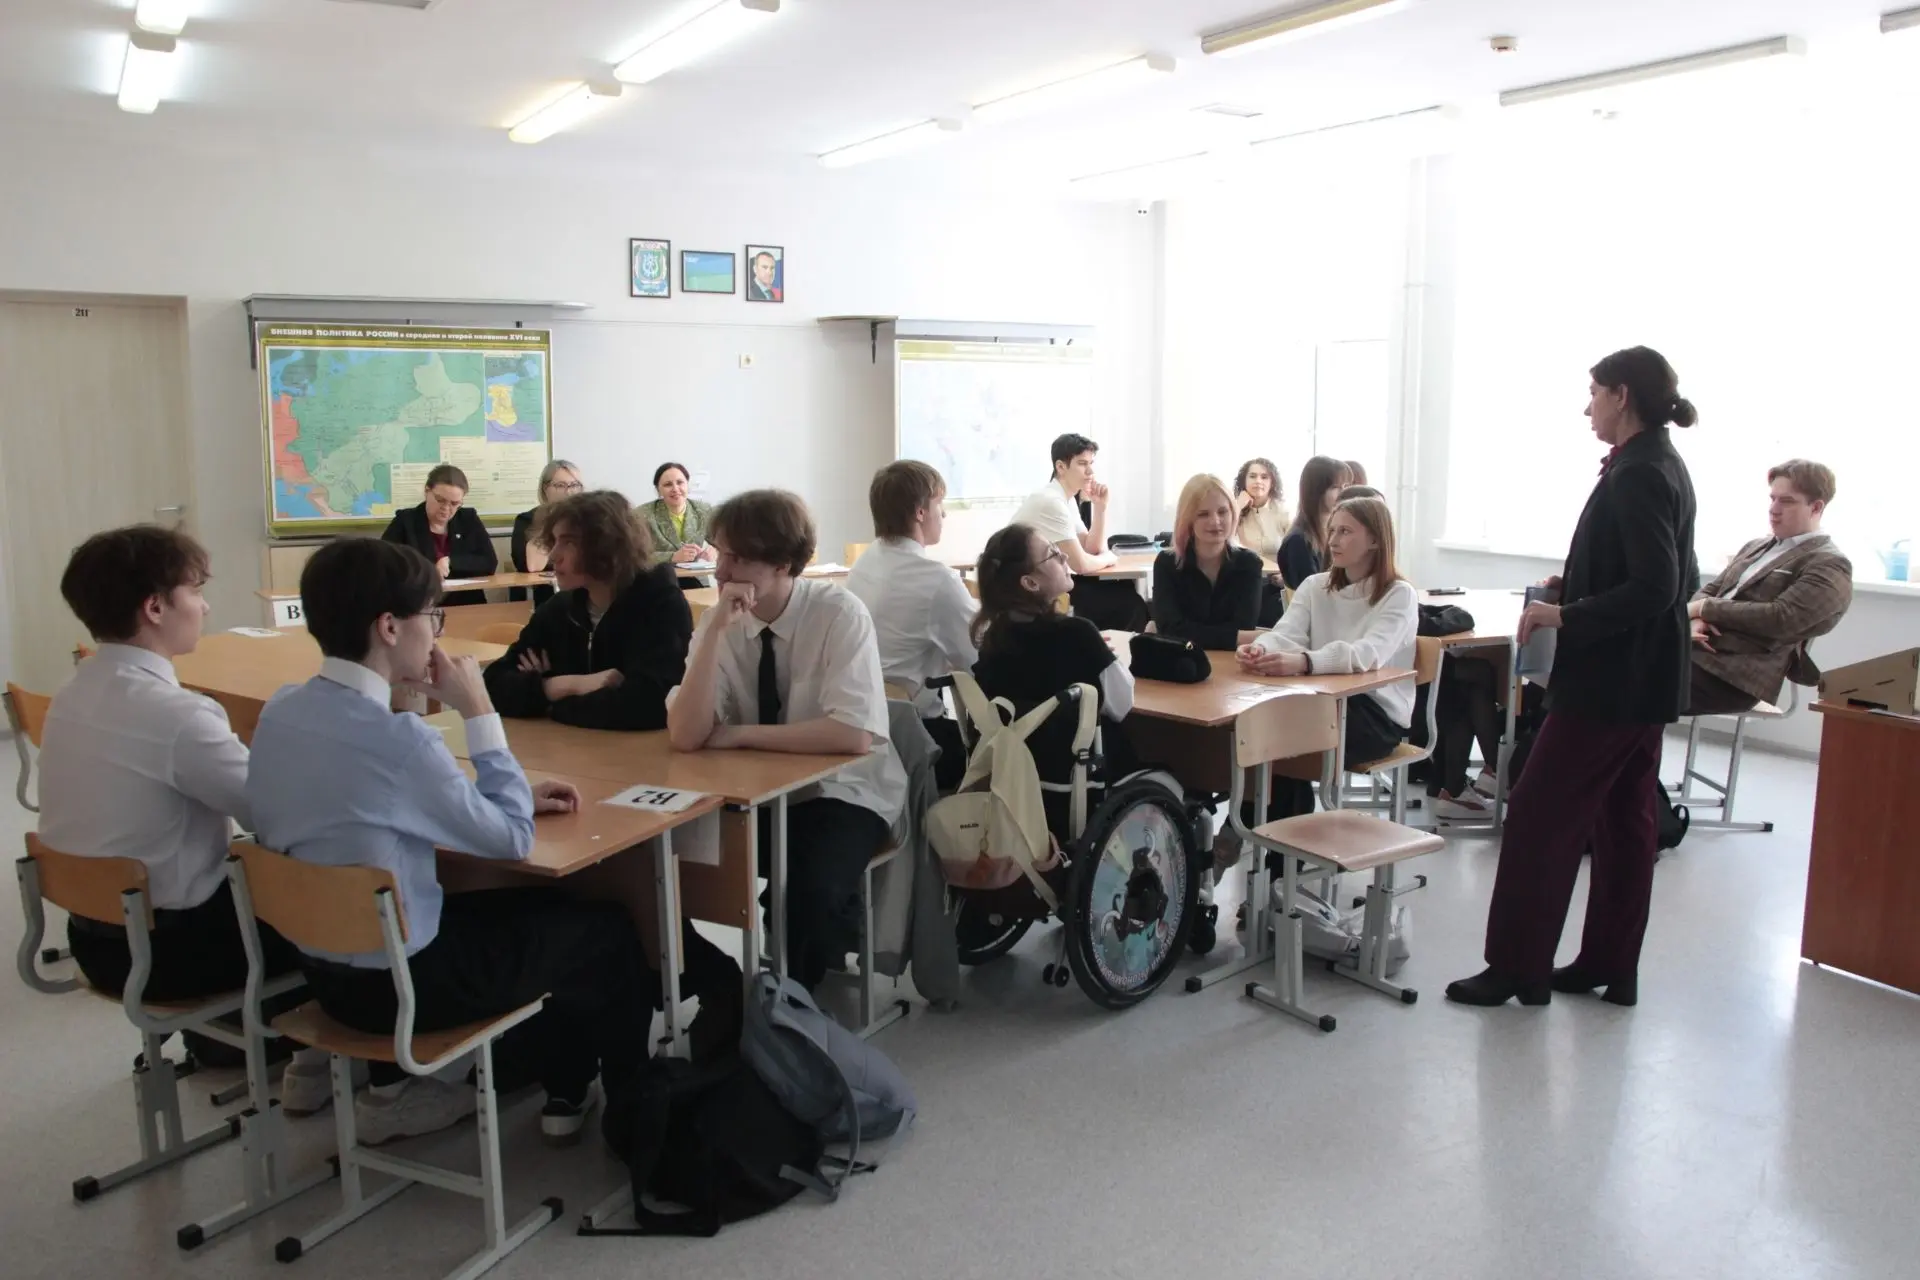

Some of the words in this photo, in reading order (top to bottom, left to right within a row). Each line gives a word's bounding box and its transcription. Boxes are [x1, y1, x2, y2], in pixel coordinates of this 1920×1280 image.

[270, 328, 313, 336] ВНЕШНЯЯ
[316, 329, 364, 337] ПОЛИТИКА
[366, 330, 399, 338] РОССИИ
